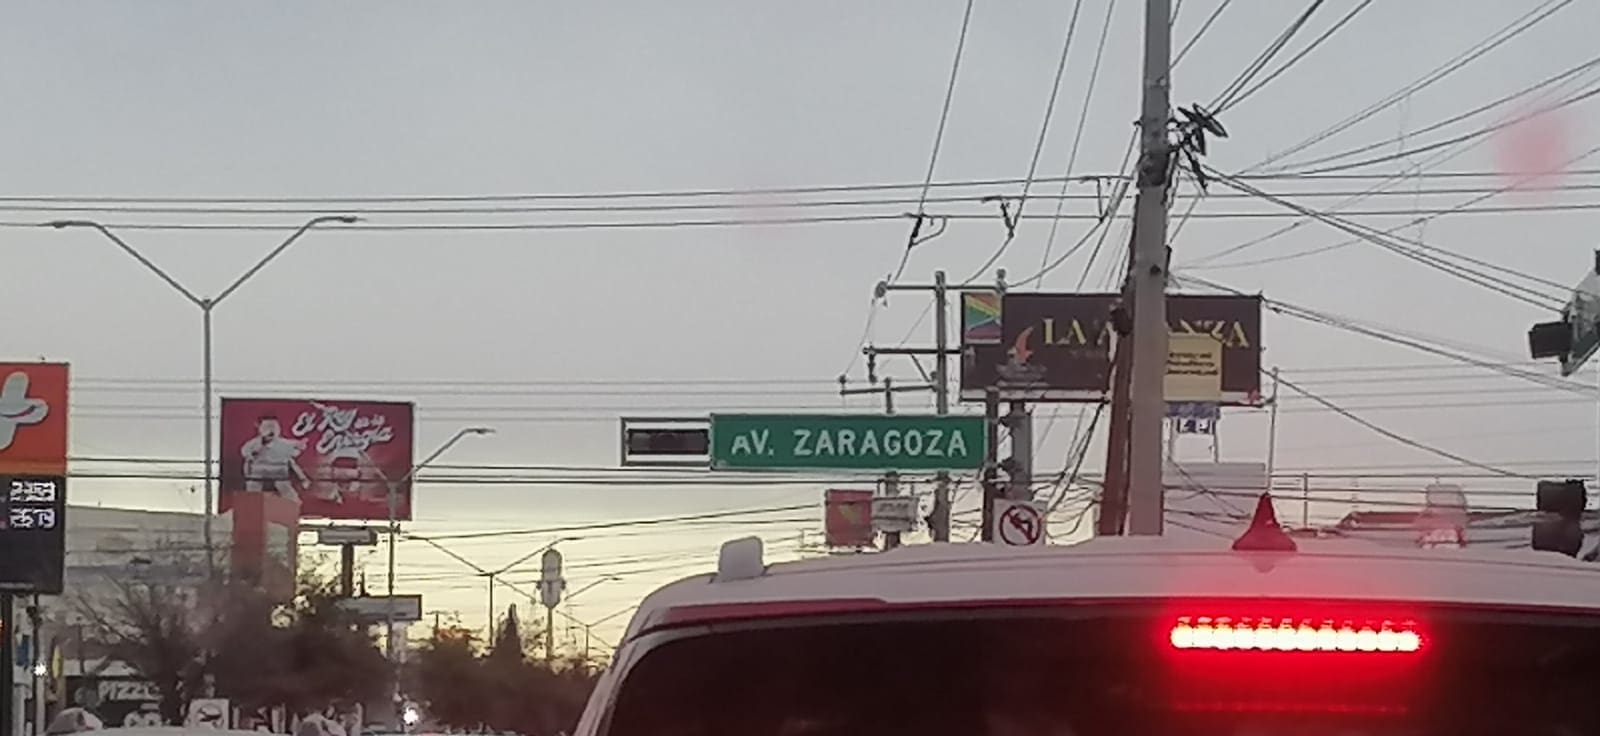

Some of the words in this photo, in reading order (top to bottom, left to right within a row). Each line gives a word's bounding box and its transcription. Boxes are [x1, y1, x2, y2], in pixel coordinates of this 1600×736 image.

[1042, 318, 1087, 345] LA
[731, 429, 774, 456] AV.
[793, 429, 967, 456] ZARAGOZA
